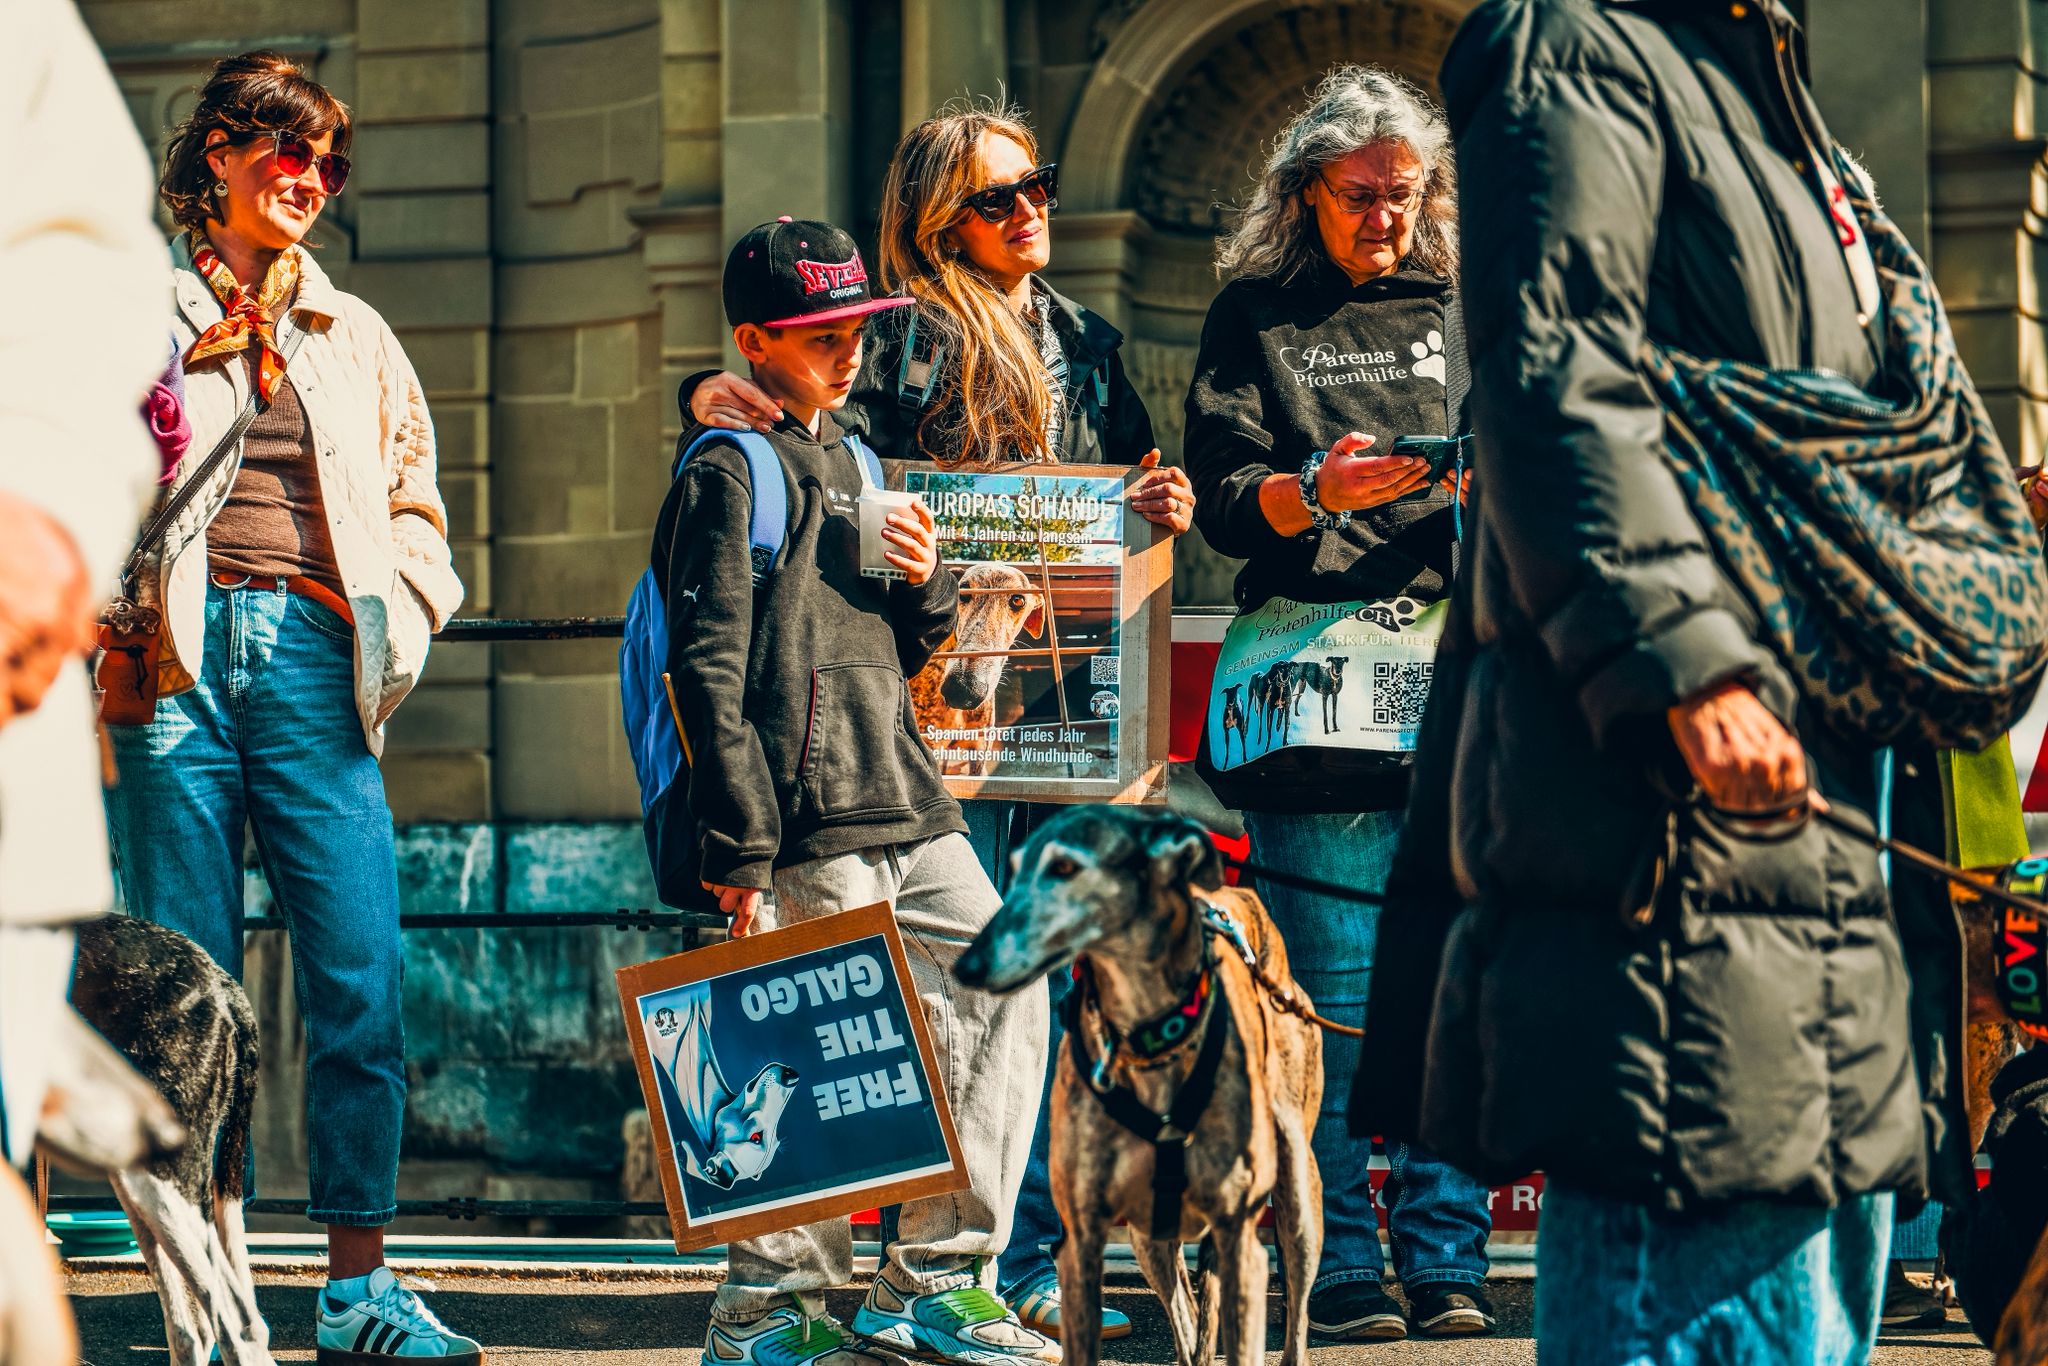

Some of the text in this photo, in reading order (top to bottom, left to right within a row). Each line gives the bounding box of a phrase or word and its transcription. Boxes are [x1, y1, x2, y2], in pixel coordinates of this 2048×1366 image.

[829, 285, 863, 299] ORIGINAL
[1280, 343, 1397, 373] Parenas
[1294, 365, 1408, 388] Pfotenhilfe
[935, 524, 1093, 546] Mit 4 Jahren zu langsam
[1224, 640, 1300, 676] GEMEINSAM
[1306, 633, 1357, 649] STARK
[1359, 632, 1392, 647] FÜR
[927, 725, 1086, 744] Spanien tötet jedes Jahr
[932, 746, 1094, 763] ehntausende Windhunde
[740, 954, 884, 1022] GALGO
[814, 1007, 906, 1062] THE
[812, 1061, 923, 1121] FREE
